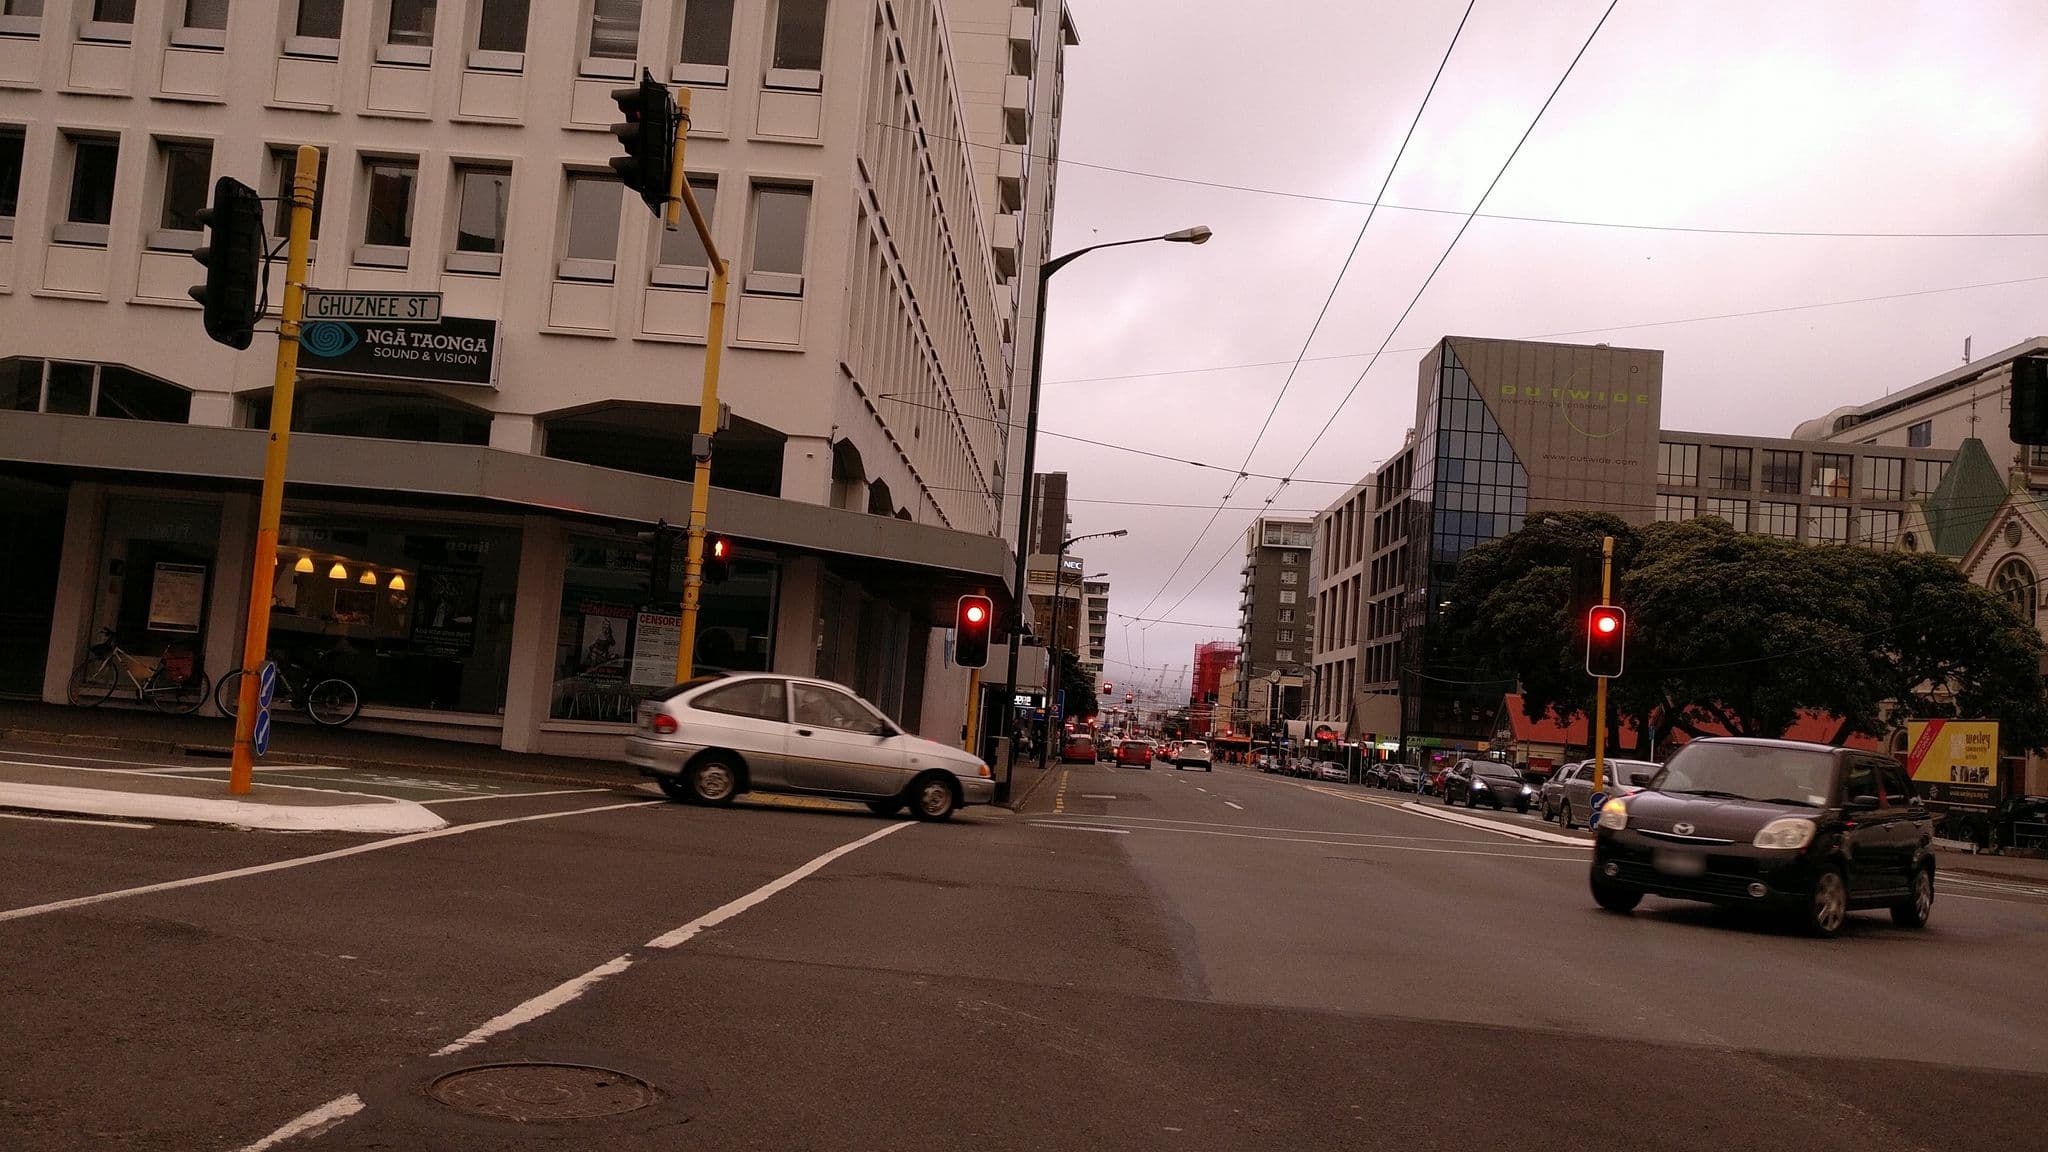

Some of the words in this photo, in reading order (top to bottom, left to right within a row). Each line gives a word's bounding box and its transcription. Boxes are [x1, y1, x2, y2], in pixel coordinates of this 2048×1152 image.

[318, 296, 399, 317] GHUZNEE
[407, 298, 429, 317] ST
[365, 328, 407, 346] NGĀ
[410, 332, 488, 353] TAONGA
[373, 347, 419, 360] SOUND
[422, 351, 431, 361] &
[434, 353, 478, 365] VISION
[1063, 560, 1083, 570] NEC
[639, 613, 681, 628] CENSORE
[1965, 731, 1991, 750] wesley
